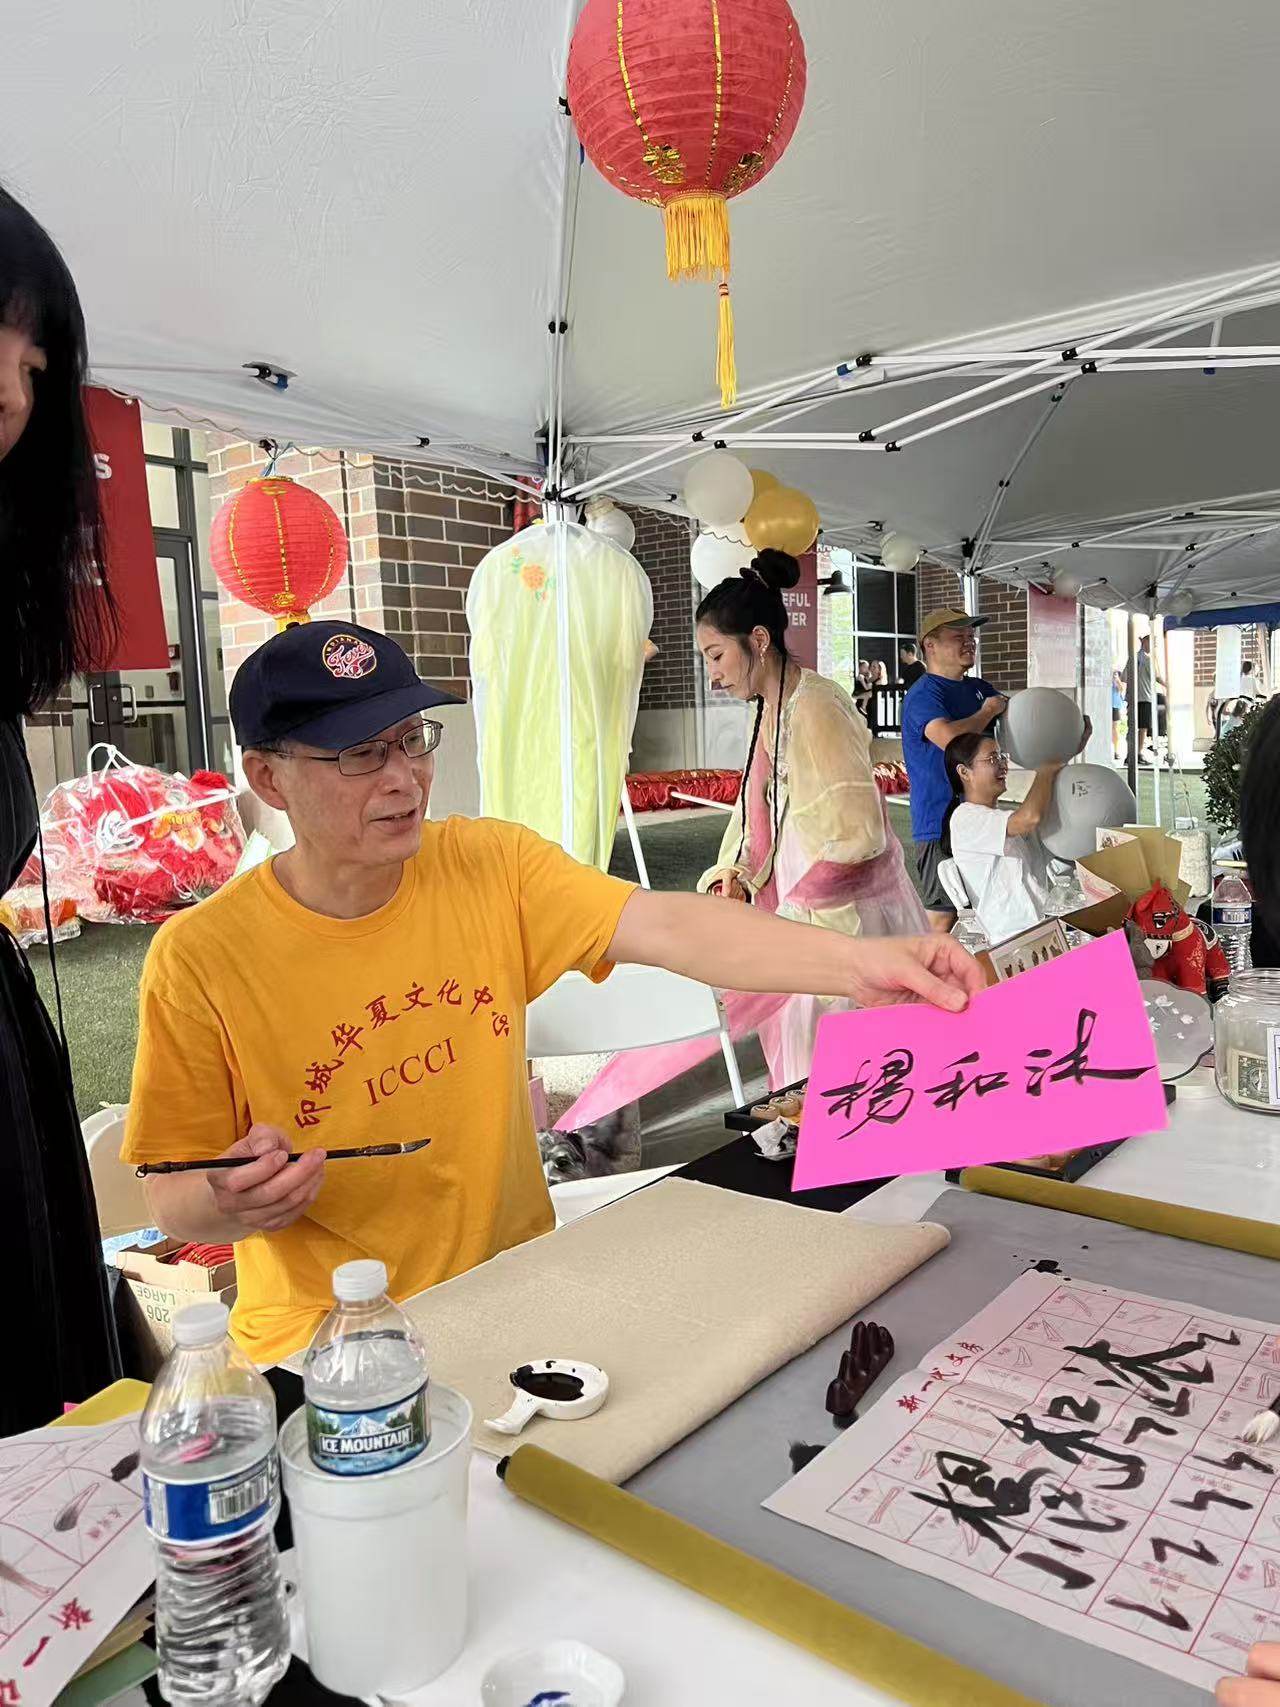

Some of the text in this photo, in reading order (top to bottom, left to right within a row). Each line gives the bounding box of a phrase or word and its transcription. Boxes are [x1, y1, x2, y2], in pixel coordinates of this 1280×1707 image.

[782, 593, 811, 608] EFUL
[294, 978, 510, 1129] 印城华夏文化中心
[362, 1036, 457, 1107] ICCCI
[136, 1285, 176, 1306] LARGE
[146, 1304, 171, 1324] 206
[321, 1427, 411, 1454] ICE MOUNTAIN
